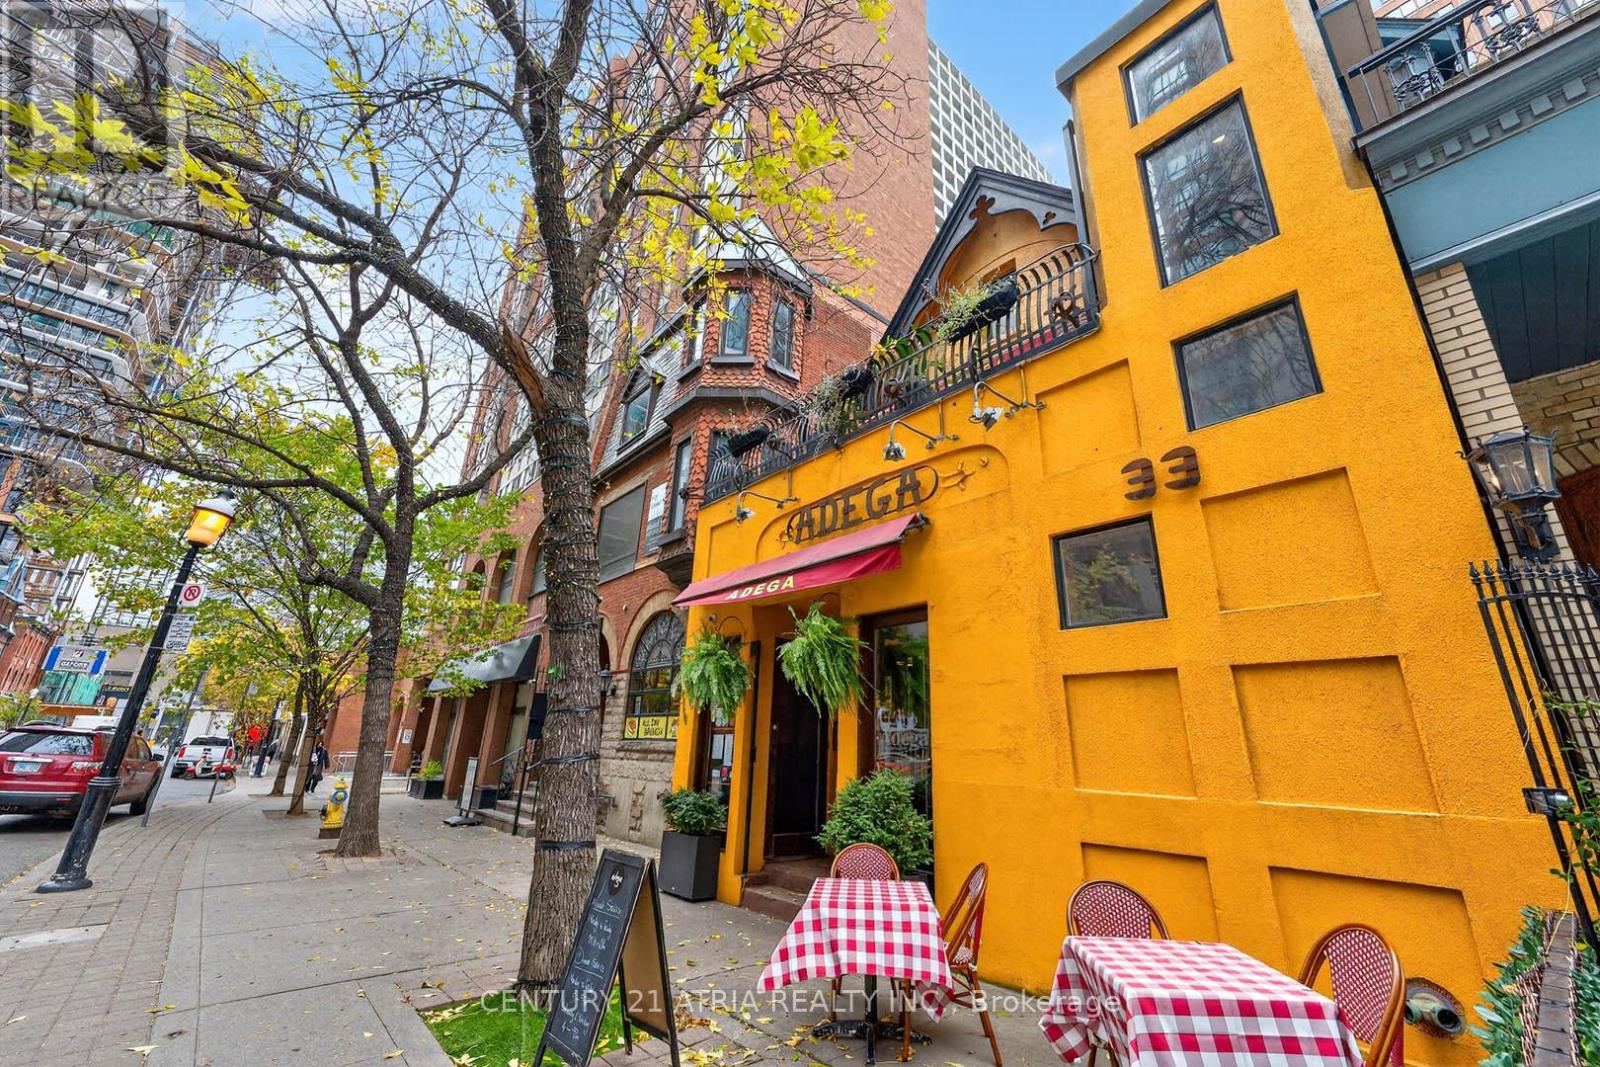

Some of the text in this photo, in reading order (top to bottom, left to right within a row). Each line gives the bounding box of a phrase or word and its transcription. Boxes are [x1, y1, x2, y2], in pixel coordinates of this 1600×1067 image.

[1121, 446, 1201, 500] 33
[795, 468, 921, 544] ADEGA
[725, 575, 795, 600] ADEGA
